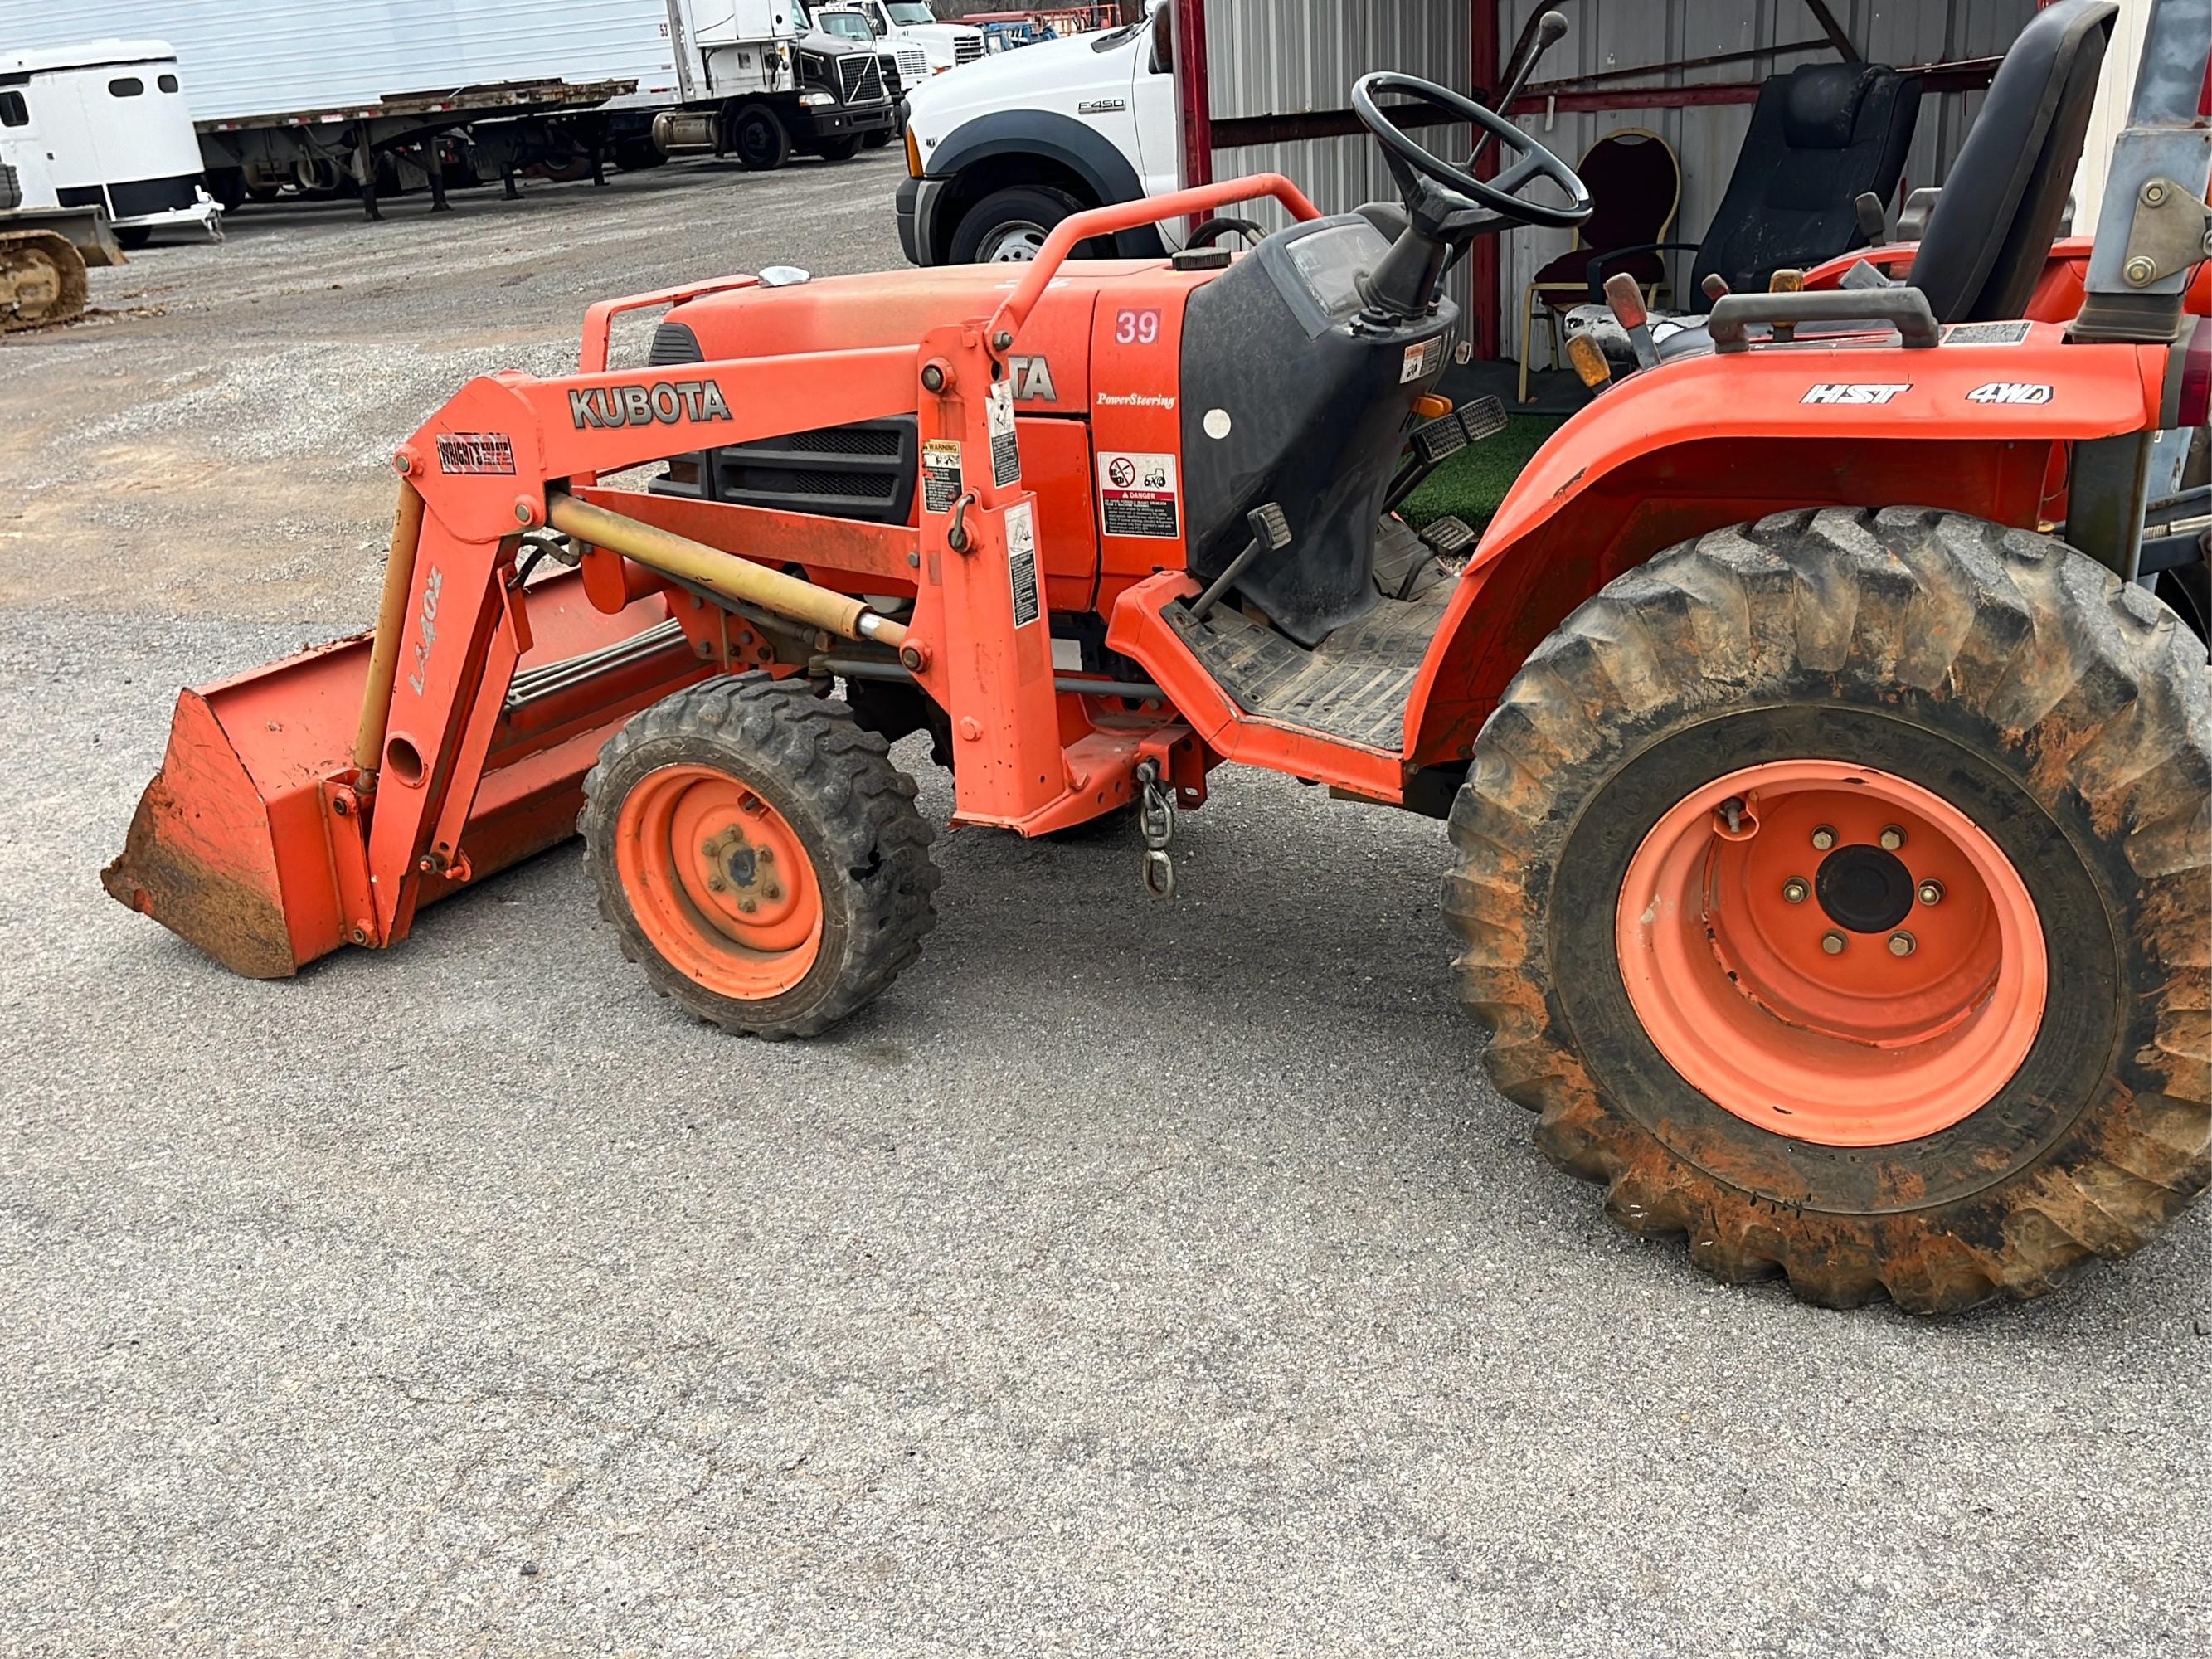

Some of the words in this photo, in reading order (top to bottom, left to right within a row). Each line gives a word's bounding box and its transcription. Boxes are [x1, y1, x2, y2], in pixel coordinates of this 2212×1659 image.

[1116, 311, 1159, 344] 39
[568, 380, 733, 429] KUBOTA
[1096, 392, 1175, 410] PowerSteering
[1799, 383, 1913, 405] HST
[1965, 382, 2054, 405] 4WD
[929, 442, 957, 452] WARNING
